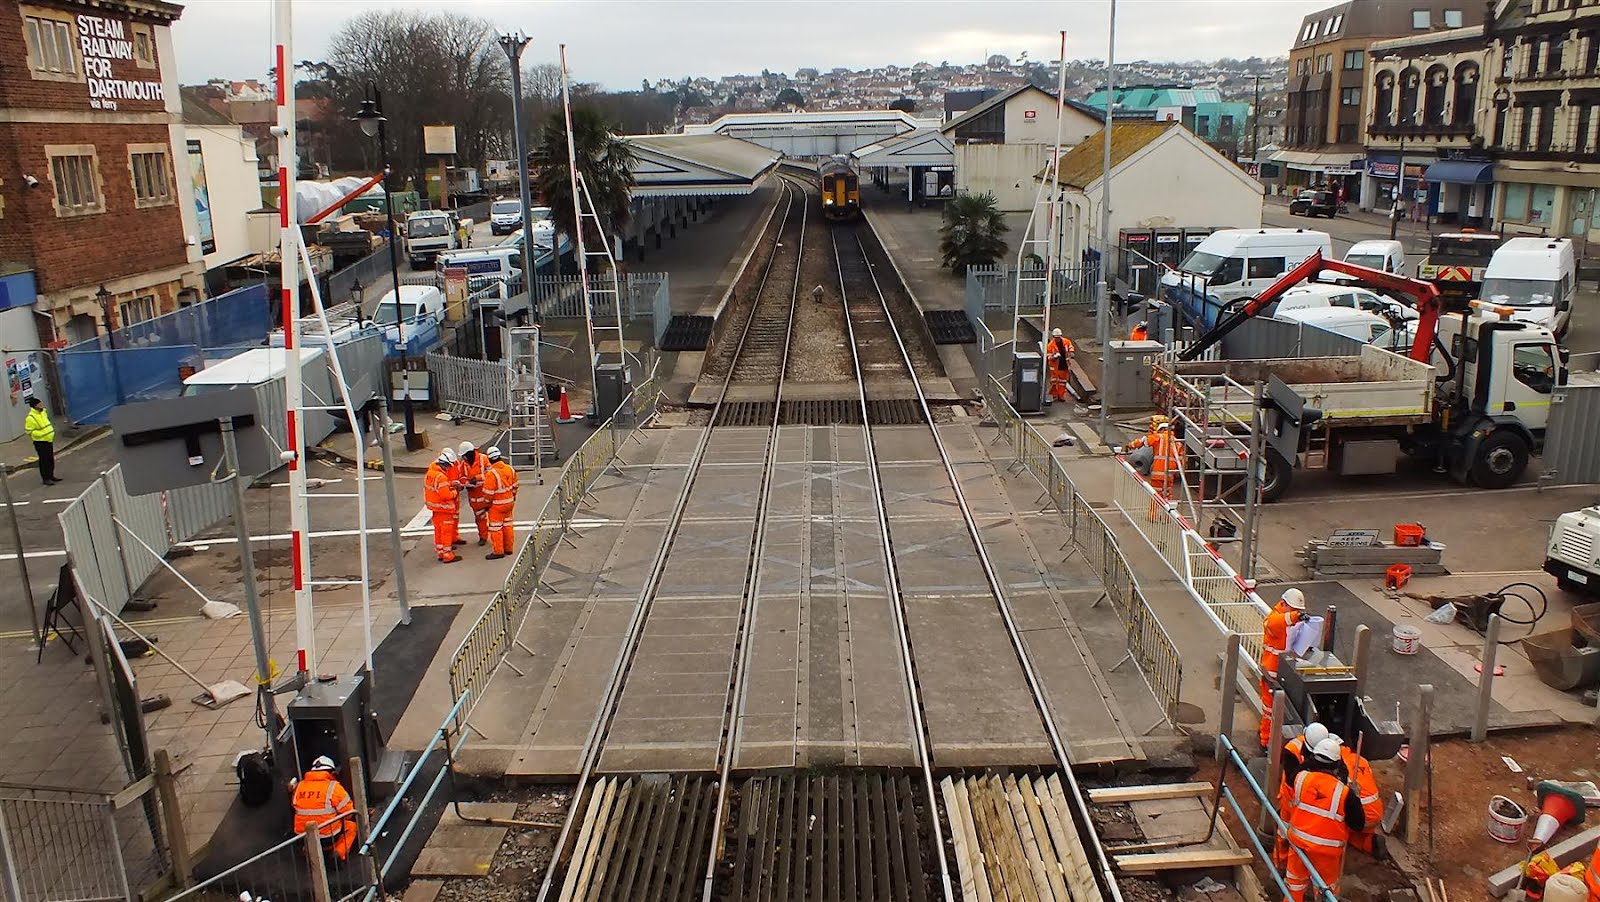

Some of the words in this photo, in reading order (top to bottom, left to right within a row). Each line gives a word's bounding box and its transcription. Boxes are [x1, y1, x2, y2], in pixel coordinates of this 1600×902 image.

[77, 14, 125, 39] STEAM
[80, 36, 133, 60] RAILWAY
[84, 57, 113, 78] FOR
[87, 78, 165, 101] DARTMOUTH
[90, 97, 101, 109] via
[101, 98, 117, 111] ferry
[298, 790, 321, 799] MPI
